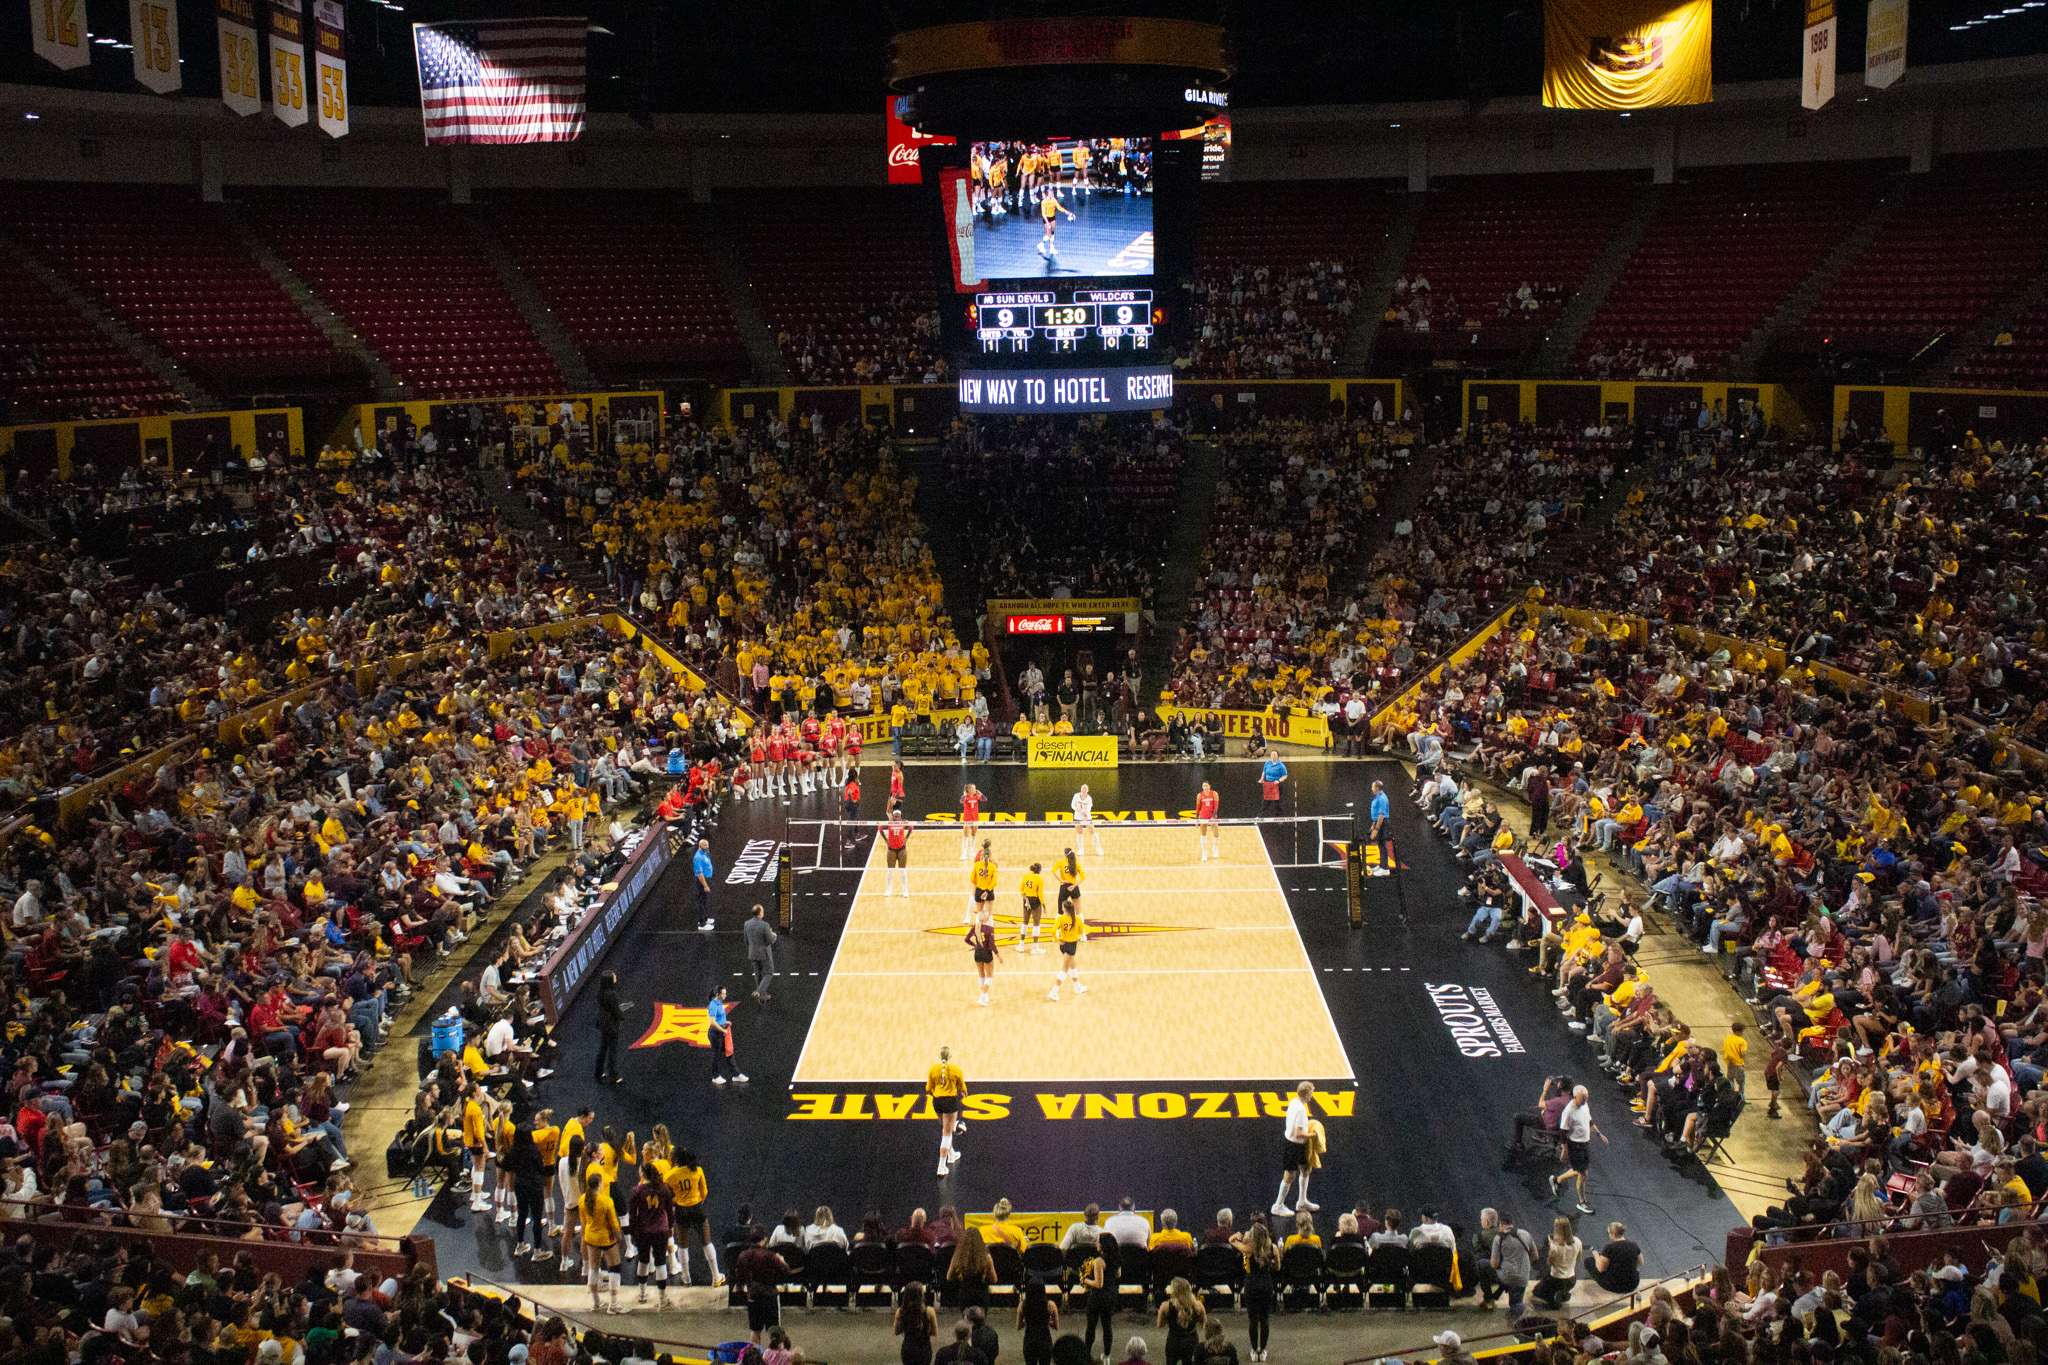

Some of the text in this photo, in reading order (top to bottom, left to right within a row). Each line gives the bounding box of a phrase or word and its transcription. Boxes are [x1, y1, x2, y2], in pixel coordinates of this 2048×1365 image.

[141, 3, 171, 72] 13
[1811, 29, 1828, 55] 1988
[224, 31, 256, 98] 32
[275, 48, 303, 109] 33
[321, 64, 345, 121] 53
[1184, 89, 1208, 103] GILA
[996, 295, 1015, 304] SUN
[1018, 294, 1049, 303] DEVILS
[1090, 292, 1134, 301] WILDCATS
[998, 308, 1014, 328] 9
[1044, 308, 1086, 324] 1:30
[1117, 306, 1133, 324] 9
[988, 340, 994, 350] 1
[1017, 340, 1022, 350] 1
[1062, 340, 1070, 348] 2
[1108, 337, 1116, 348] 0
[1137, 336, 1146, 348] 2
[987, 379, 1017, 404] WAY
[1024, 379, 1046, 404] TO
[1054, 378, 1110, 404] HOTEL
[1018, 618, 1053, 631] Coca-Cola
[1036, 739, 1074, 750] desert
[1045, 750, 1110, 762] FINANCIAL
[725, 839, 776, 884] SPROUTS
[1025, 880, 1033, 888] 43
[568, 956, 580, 988] NEW
[1426, 984, 1502, 1058] SPROUTS
[1468, 986, 1526, 1054] FARMERS MARKET
[786, 1091, 1356, 1120] ARIZONA STATE
[678, 1179, 691, 1192] 10
[1022, 1221, 1062, 1242] ert
